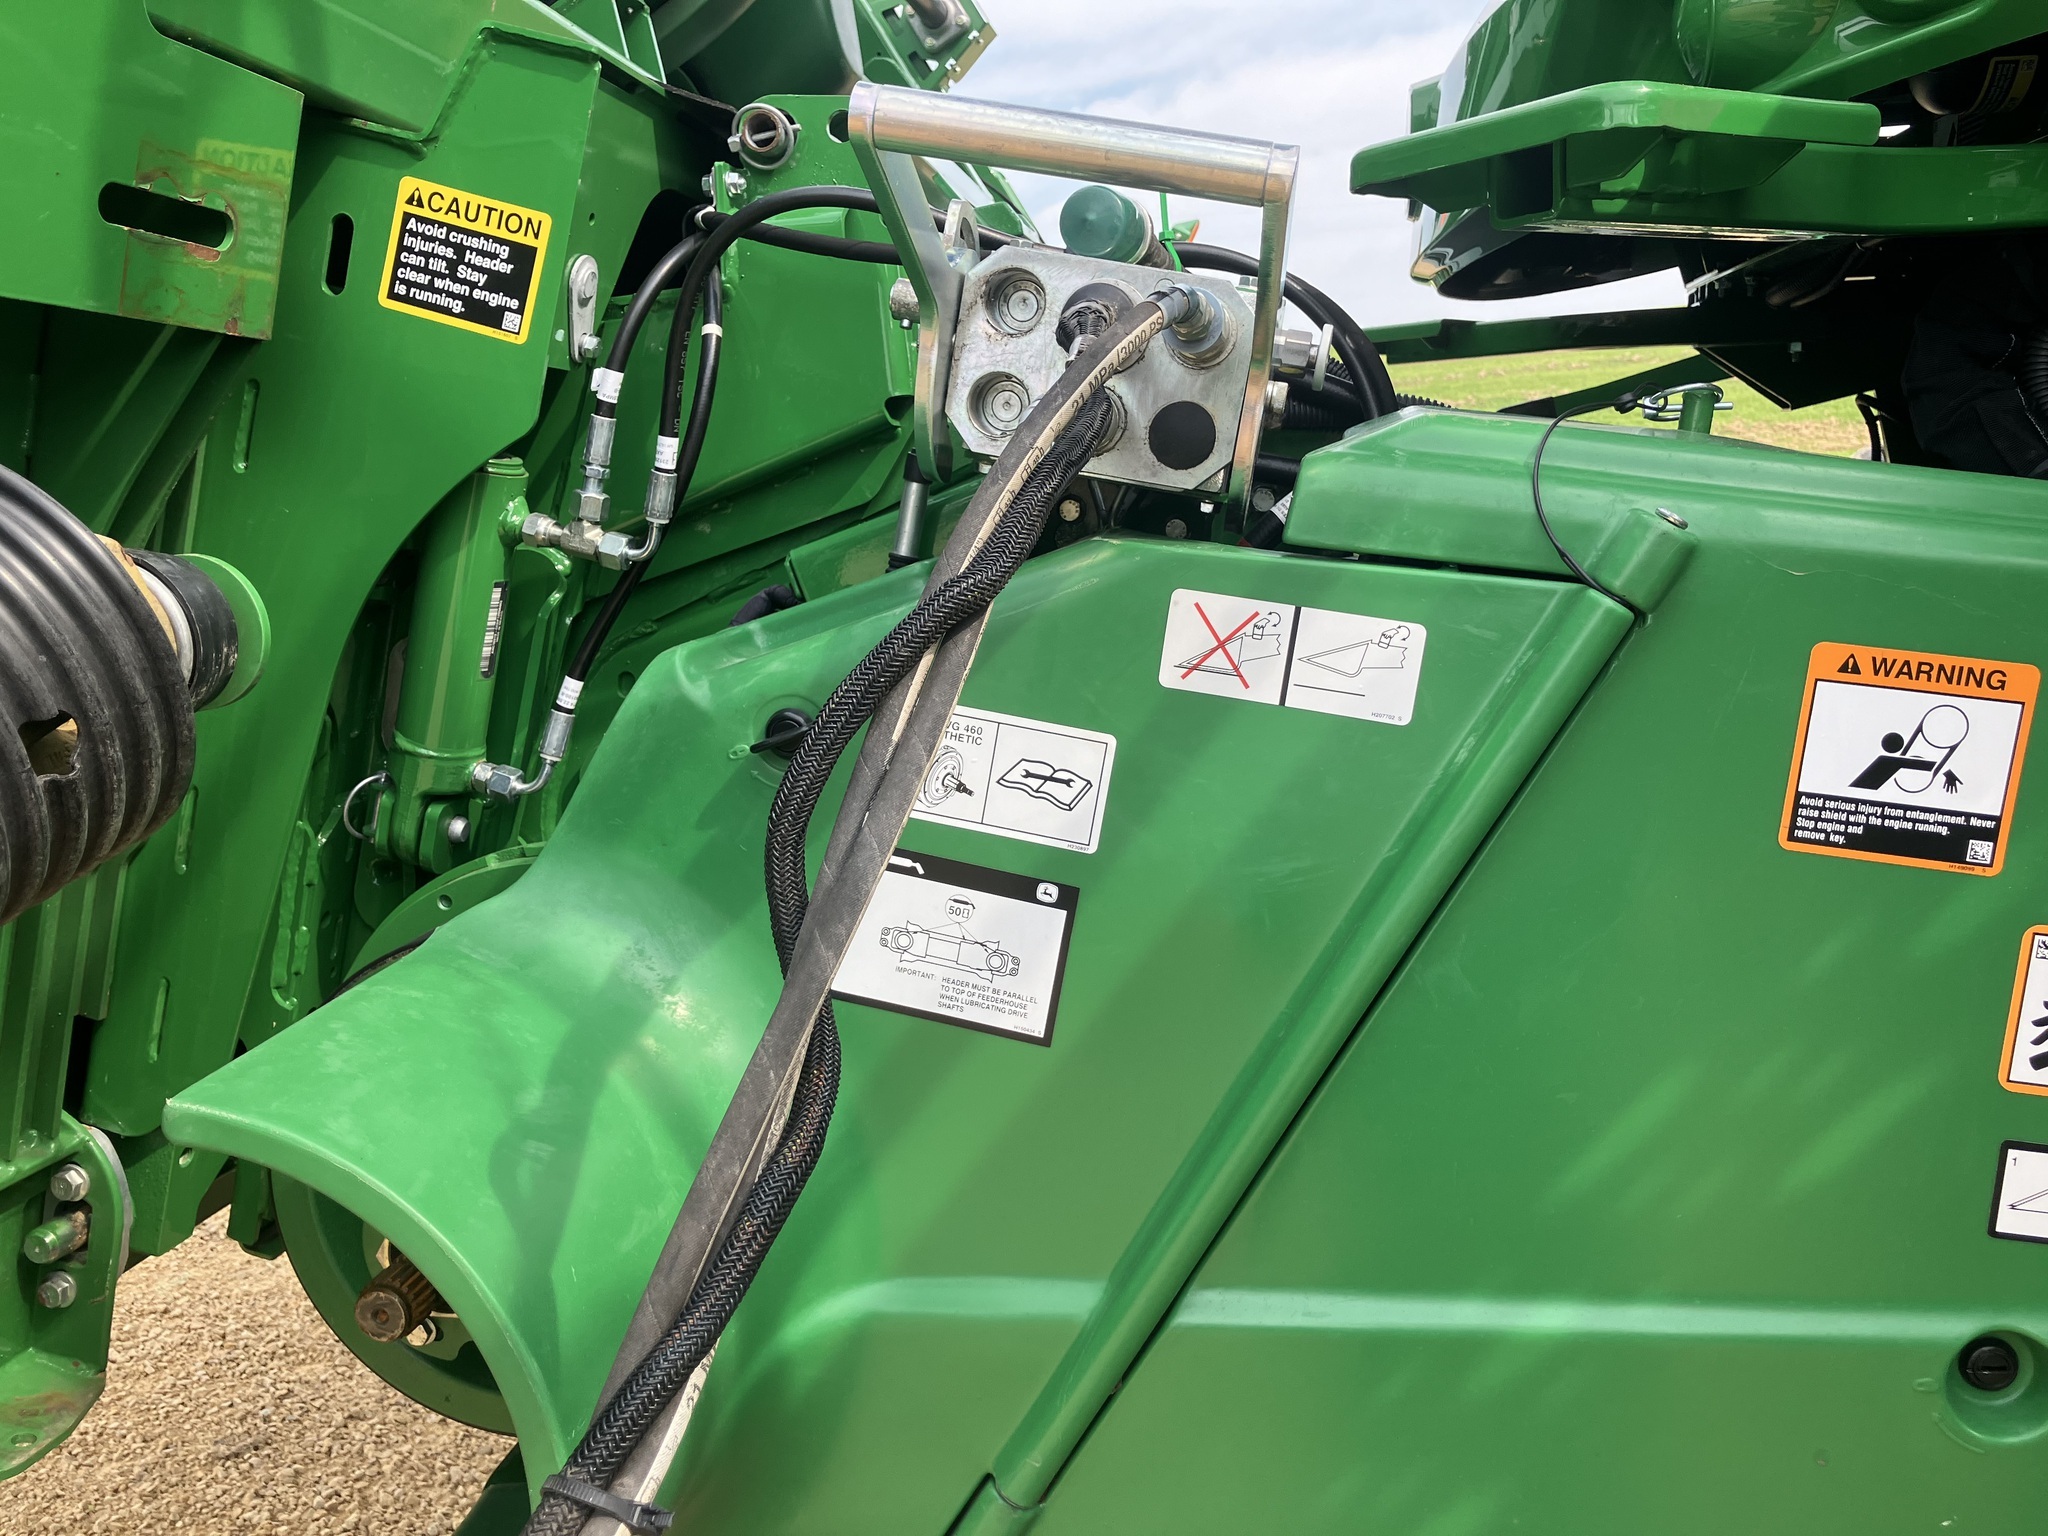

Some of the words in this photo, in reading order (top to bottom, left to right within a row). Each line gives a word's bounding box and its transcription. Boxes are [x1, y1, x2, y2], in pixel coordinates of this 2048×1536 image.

[427, 191, 542, 240] CAUTION
[406, 217, 447, 240] Avoid
[449, 231, 510, 259] crushing
[403, 233, 457, 260] injuries.
[464, 250, 514, 274] Header
[400, 251, 425, 267] can
[428, 256, 450, 274] tilt.
[456, 265, 488, 287] Stay
[394, 281, 407, 295] is
[409, 287, 465, 314] running.
[397, 267, 431, 285] clear
[433, 277, 470, 296] when
[472, 288, 519, 309] engine
[1087, 362, 1115, 393] MPa
[1871, 655, 2007, 692] WARNING
[944, 730, 983, 746] THETIC
[963, 724, 983, 736] 460
[1798, 806, 1819, 818] raise
[1820, 809, 1847, 822] shield
[1848, 812, 1867, 824] with
[1868, 816, 1882, 826] the
[1883, 818, 1913, 831] engine
[1914, 822, 1950, 836] running.
[1799, 795, 1824, 808] Avoid
[1824, 798, 1856, 812] serious
[1857, 802, 1883, 816] injury
[1883, 805, 1904, 818] from
[1905, 809, 1967, 825] entanglement.
[1969, 816, 1996, 829] Never
[1794, 829, 1825, 841] remove
[1829, 832, 1846, 844] key.
[1796, 818, 1815, 830] Stop
[1816, 821, 1845, 835] engine
[1847, 824, 1863, 835] and
[947, 905, 962, 917] 50
[895, 966, 937, 982] IMPORTANT:
[941, 976, 970, 989] HEADER
[970, 982, 990, 993] MUST
[991, 987, 1002, 996] BE
[1003, 990, 1038, 1004] PARALLEL
[941, 985, 950, 993] TO
[951, 987, 966, 996] TOP
[966, 990, 977, 998] OF
[977, 992, 1028, 1010] FEEDERHOUSE
[937, 1001, 965, 1013] SHAFTS
[939, 993, 960, 1004] WHEN
[961, 997, 1007, 1014] LUBRICATING
[1008, 1008, 1028, 1019] DRIVE
[2012, 1157, 2017, 1166] 1
